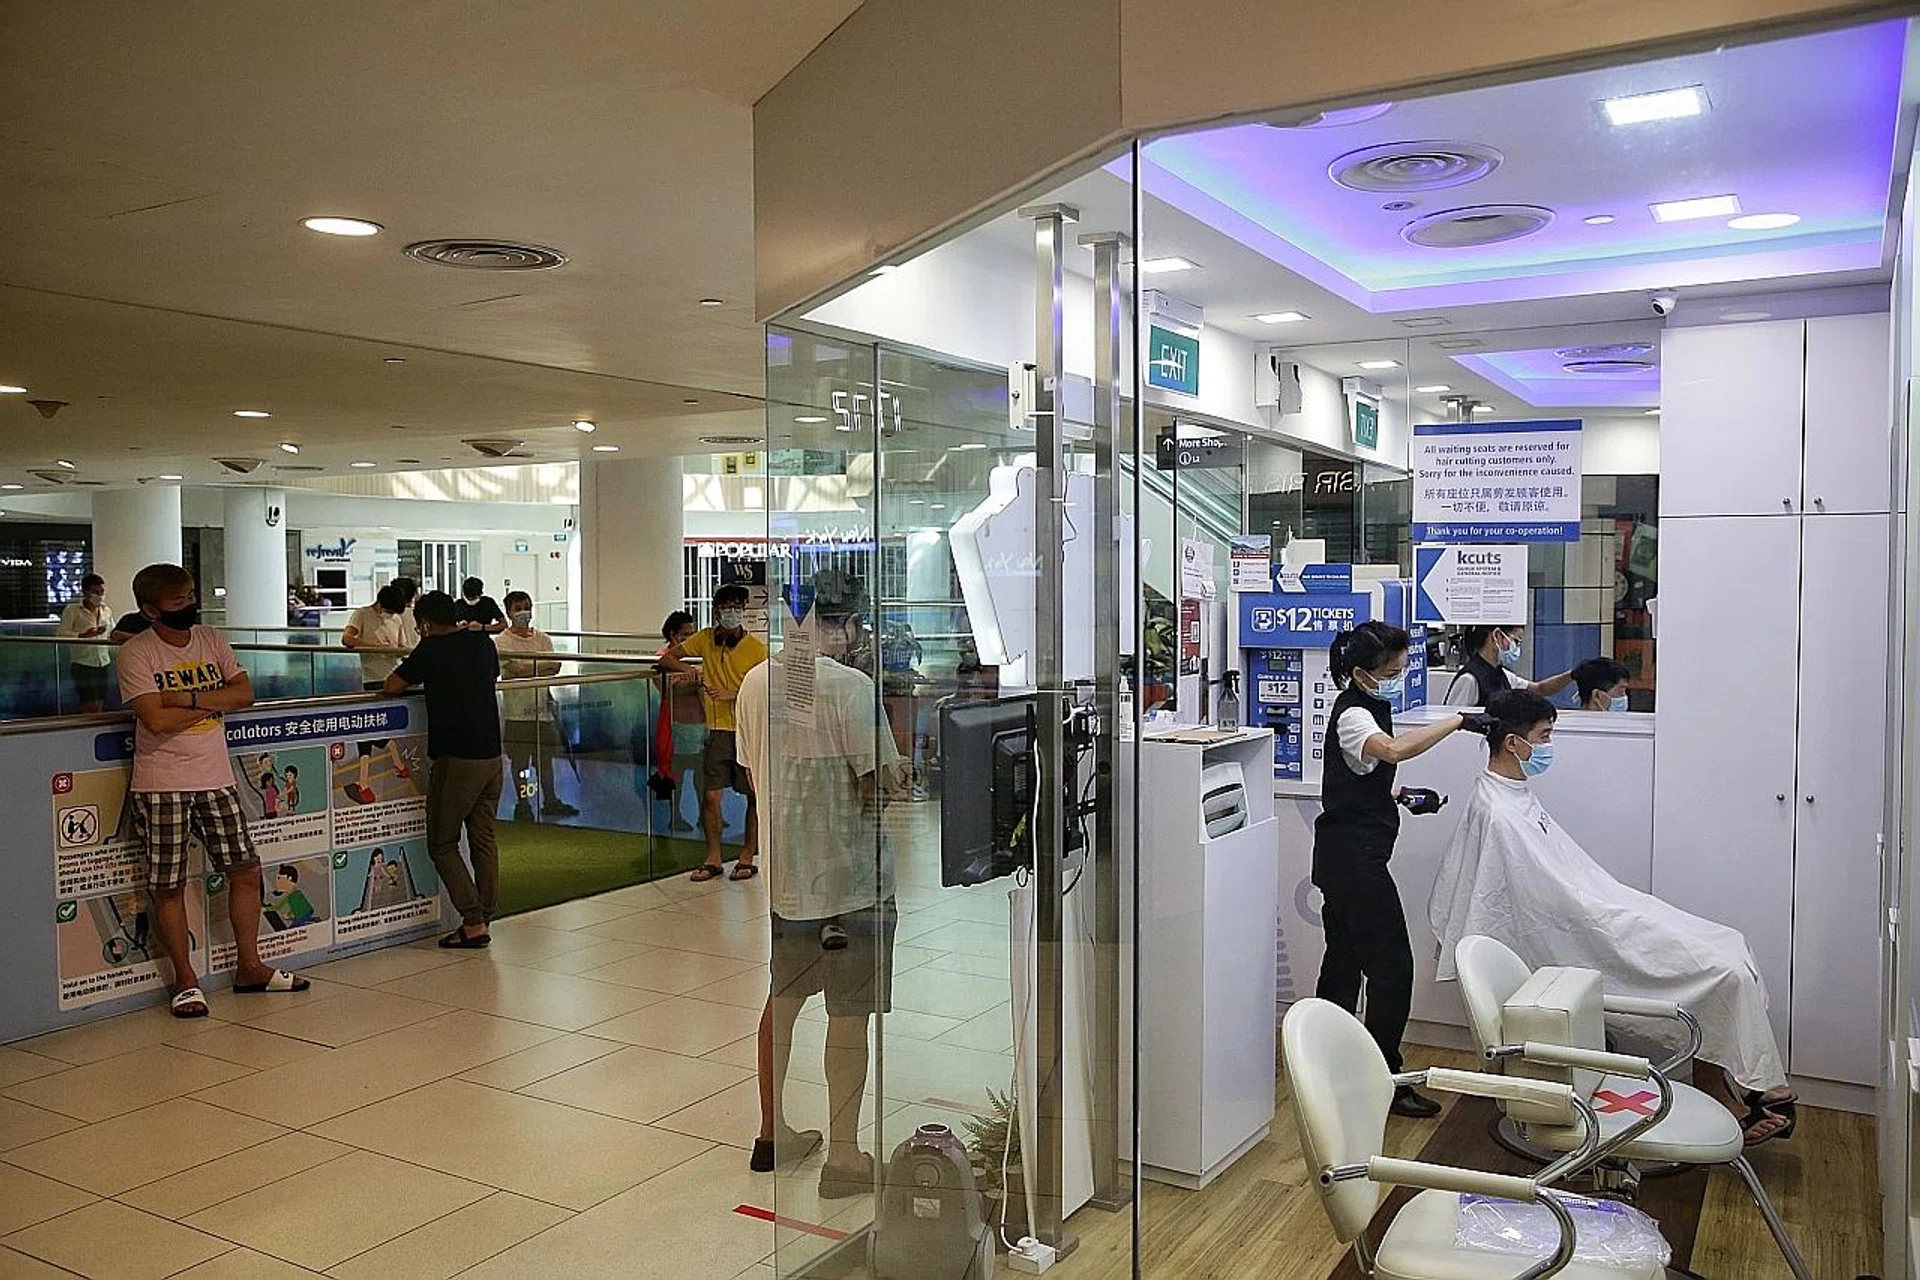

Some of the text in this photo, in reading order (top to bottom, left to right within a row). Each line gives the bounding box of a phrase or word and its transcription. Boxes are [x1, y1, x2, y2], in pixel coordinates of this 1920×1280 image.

[1161, 344, 1188, 383] EXIT
[1179, 439, 1200, 448] More
[1424, 441, 1570, 455] All waiting seats are reserved for
[1435, 454, 1557, 467] hair cutting customers only.
[1419, 466, 1575, 479] Sorry for the inconvenience caused.
[1426, 526, 1563, 537] Thank you for your co-operation!
[715, 542, 793, 558] POPULAR
[1457, 550, 1501, 565] kcuts
[1276, 608, 1354, 631] $12 TICKETS
[1268, 683, 1288, 694] $12
[226, 711, 389, 741] calators 安全使用电动扶梯
